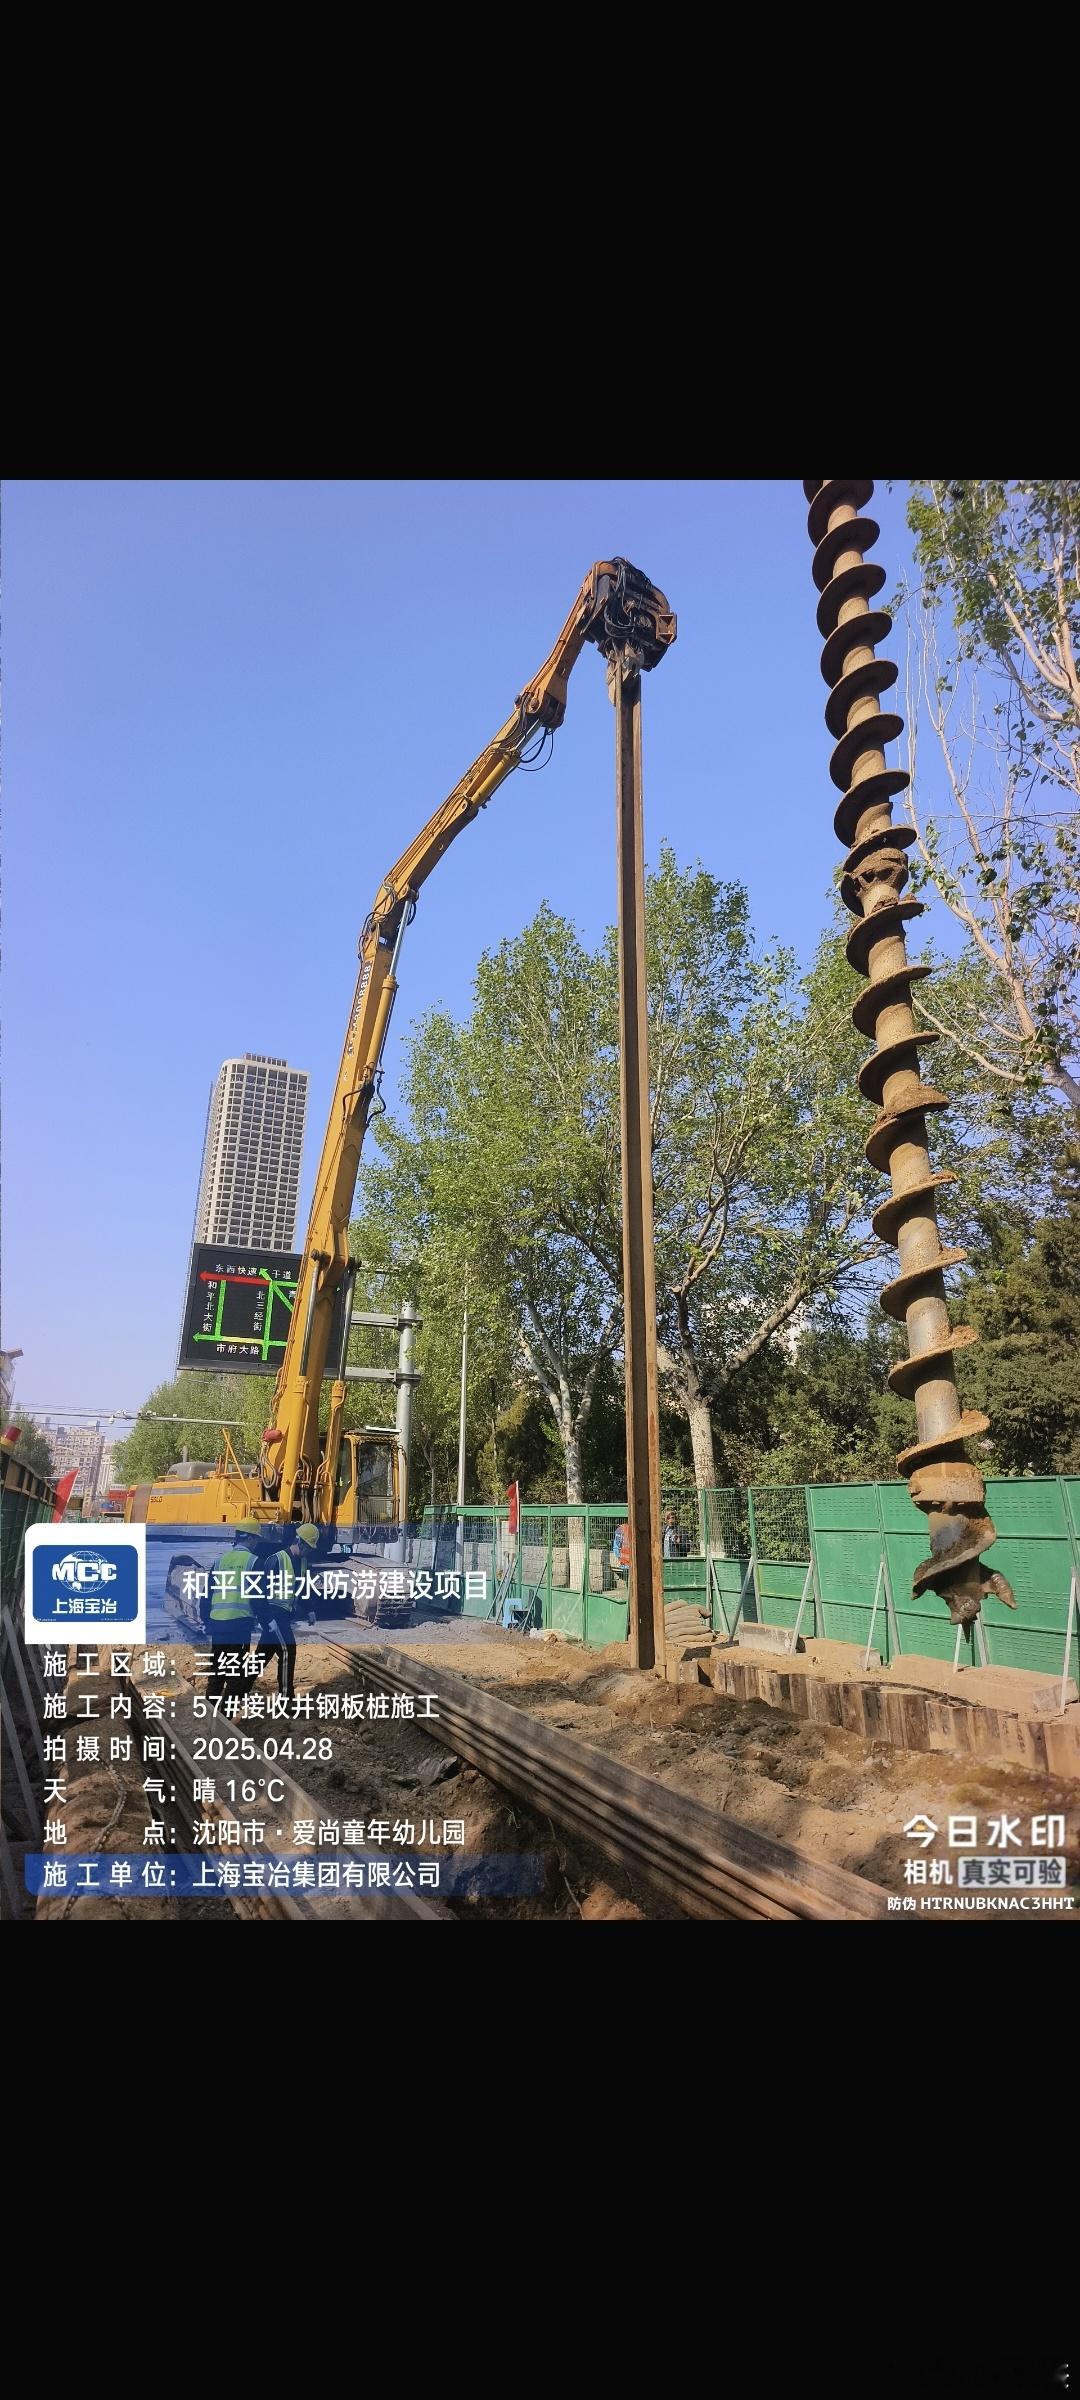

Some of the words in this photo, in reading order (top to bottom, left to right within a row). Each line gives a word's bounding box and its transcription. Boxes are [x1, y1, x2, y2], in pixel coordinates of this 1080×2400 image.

[202, 1281, 218, 1332] 和平北大街
[252, 1290, 265, 1331] 北三经街
[216, 1343, 260, 1355] 市府大路
